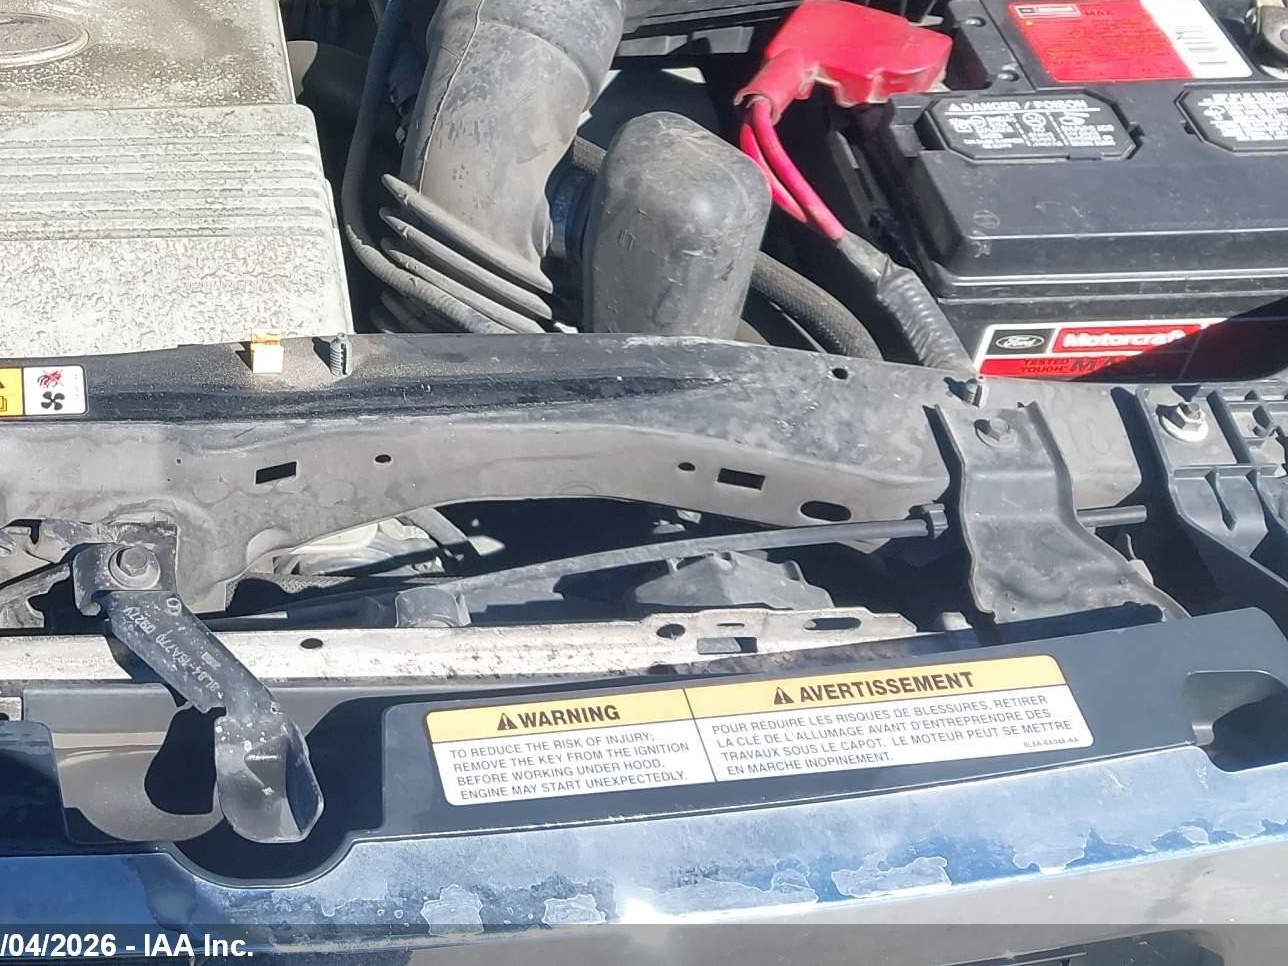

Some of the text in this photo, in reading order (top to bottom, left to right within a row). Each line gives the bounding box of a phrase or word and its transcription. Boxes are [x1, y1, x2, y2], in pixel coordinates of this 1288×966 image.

[961, 99, 1088, 111] DANGER POISON
[1002, 335, 1036, 348] Ford
[800, 671, 974, 704] AVERTISSEMENT
[519, 705, 620, 729] WARNING
[712, 695, 1048, 735] POUR RÉDUIRE LES RISQUES DE BLESSURES, RETIRER
[718, 708, 1051, 748] LA CLÉ DE L'ALLUMAGE AVANT D'ENTREPRENDRE DES
[450, 733, 655, 759] TO REDUCE THE RISK OF INJURY;
[722, 720, 1073, 763] TRAVAUX SOUS LE CAPOT. LE MOTEUR PEUT SE METTRE
[454, 744, 689, 773] REMOVE THE KEY FROM THE IGNITION
[457, 759, 665, 786] BEFORE WORKING UNDER HOOD.
[727, 765, 744, 776] EN
[748, 760, 802, 774] MARCHE
[461, 771, 688, 800] ENGINE MAY START UNEXPECTEDLY.
